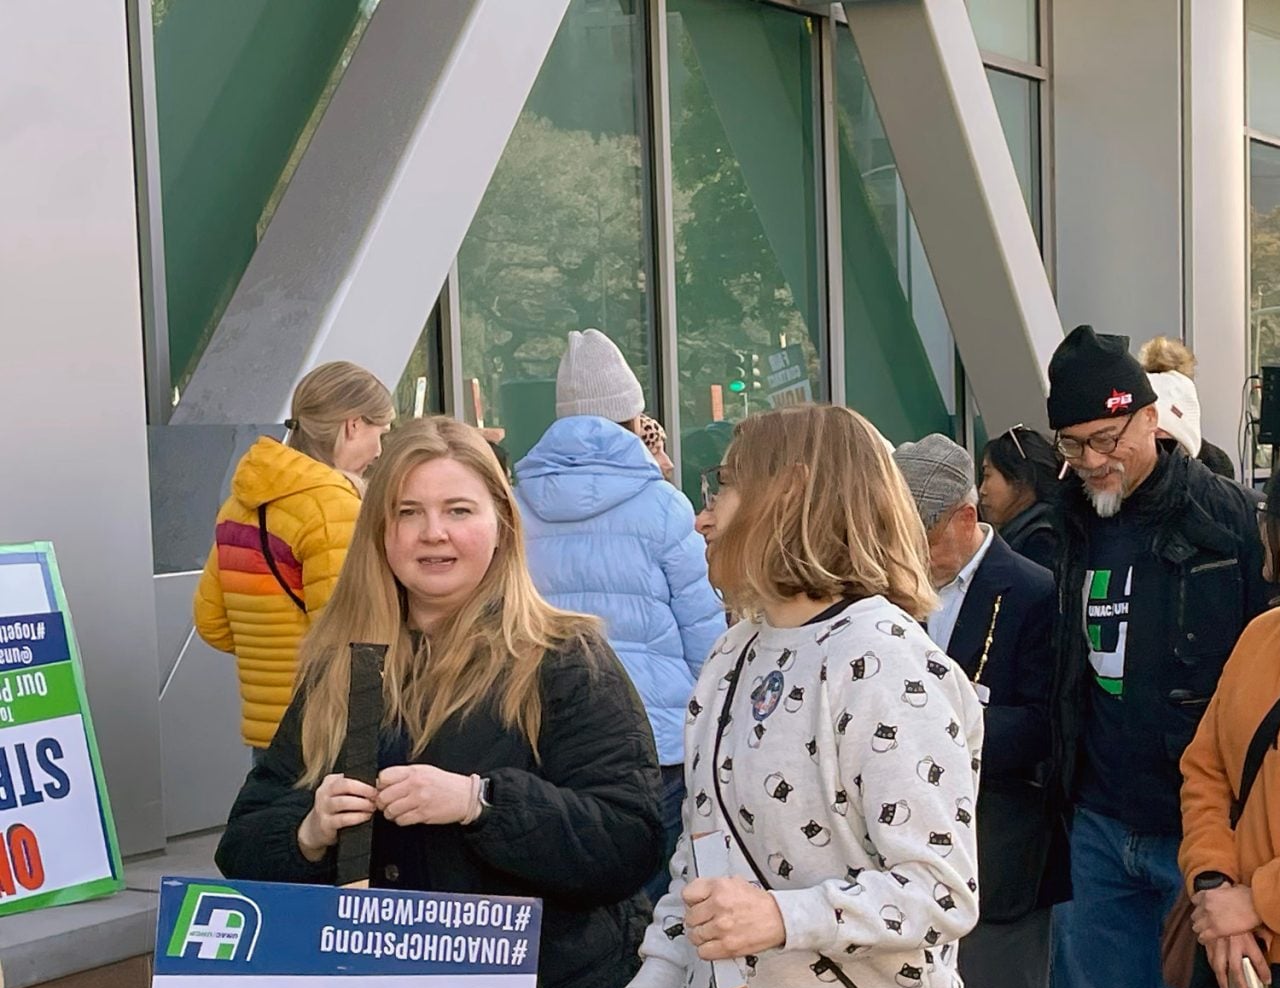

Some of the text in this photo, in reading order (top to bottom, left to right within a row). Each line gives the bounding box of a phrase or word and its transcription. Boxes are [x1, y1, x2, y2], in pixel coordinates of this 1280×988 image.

[17, 671, 48, 698] Our
[338, 895, 532, 932] #TogetherWeWin
[320, 926, 528, 966] #UNACUHCPstrong
